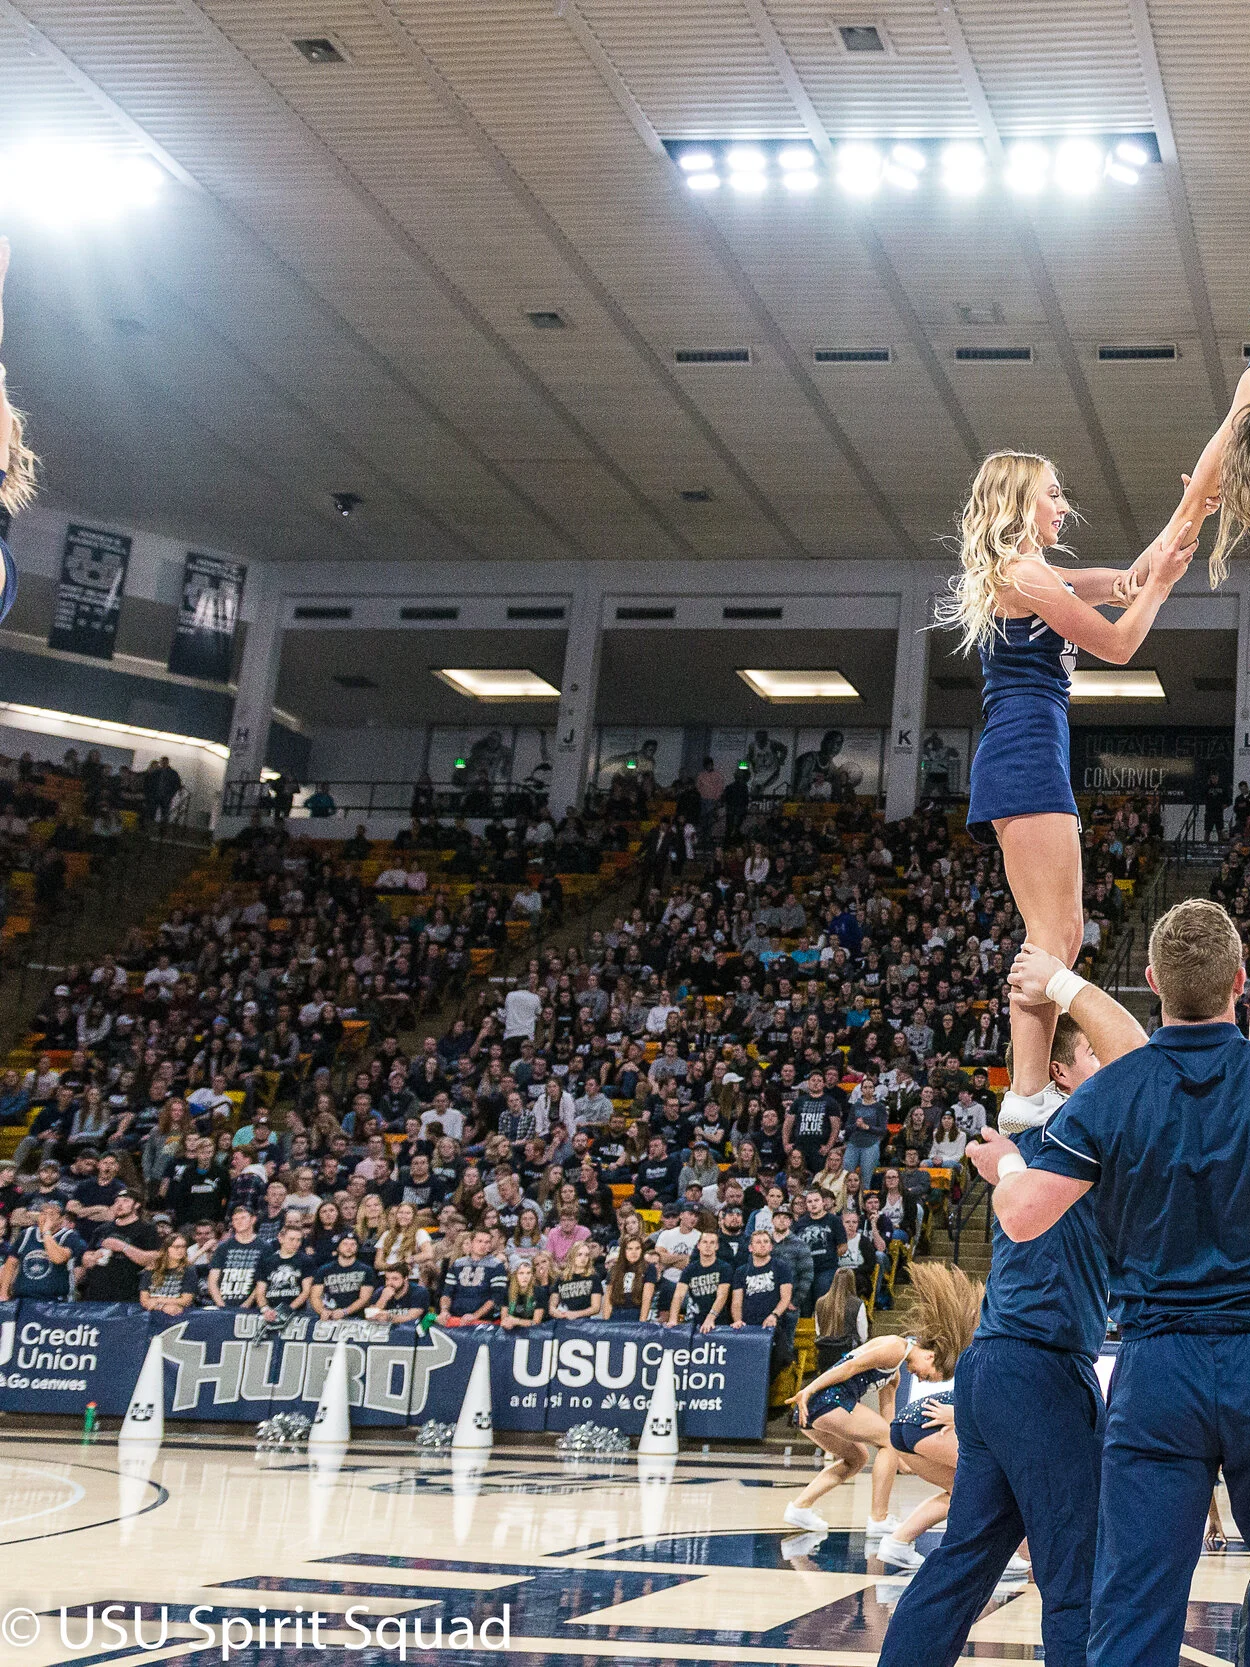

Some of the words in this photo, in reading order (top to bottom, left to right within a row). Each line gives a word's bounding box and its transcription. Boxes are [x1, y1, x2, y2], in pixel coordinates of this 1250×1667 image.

[563, 728, 575, 744] J
[898, 729, 912, 745] K
[801, 1112, 825, 1121] TRUE
[222, 1268, 256, 1282] TRUE
[220, 1282, 253, 1295] BLUE
[20, 1322, 100, 1347] Credit
[234, 1314, 310, 1340] UH
[312, 1319, 392, 1343] STATE
[17, 1347, 97, 1371] Union
[641, 1342, 727, 1365] Cedit
[512, 1338, 638, 1389] USU
